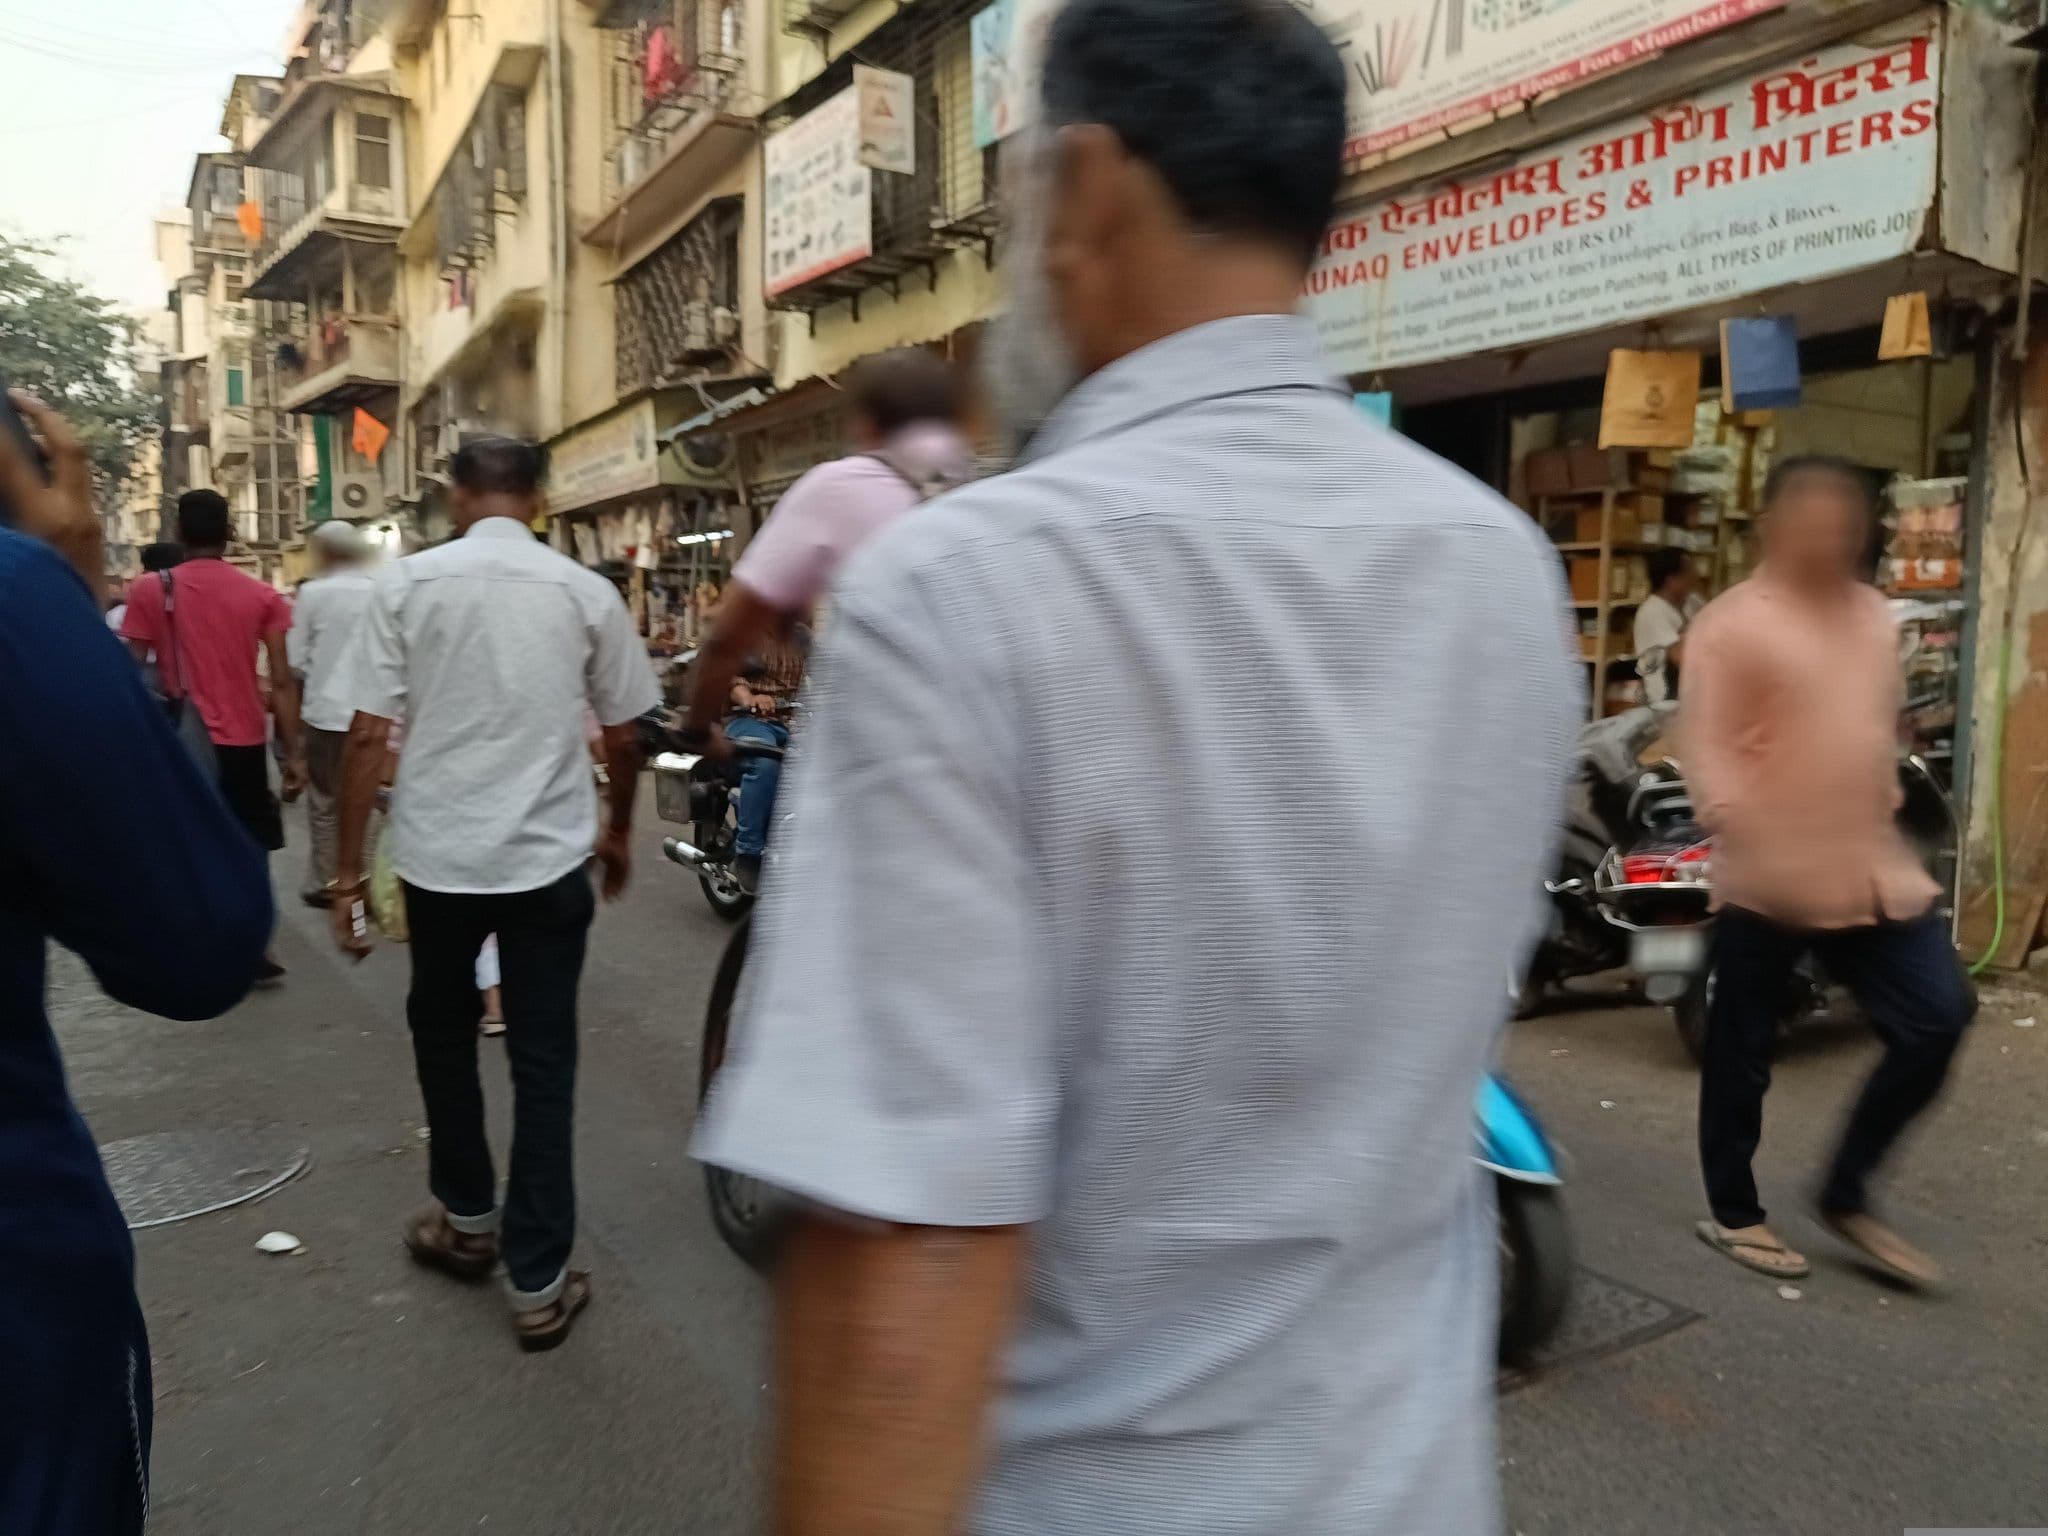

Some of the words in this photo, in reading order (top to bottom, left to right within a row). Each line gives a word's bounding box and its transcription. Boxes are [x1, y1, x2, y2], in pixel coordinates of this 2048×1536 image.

[1577, 101, 1733, 180] आणि
[1403, 191, 1607, 270] ENVELOPES
[1625, 179, 1653, 209] &
[1674, 99, 1935, 196] PRINTERS
[1676, 258, 1705, 278] ALL
[1711, 244, 1761, 271] TYPES
[1766, 238, 1789, 260] OF
[1794, 217, 1878, 254] PRINTING
